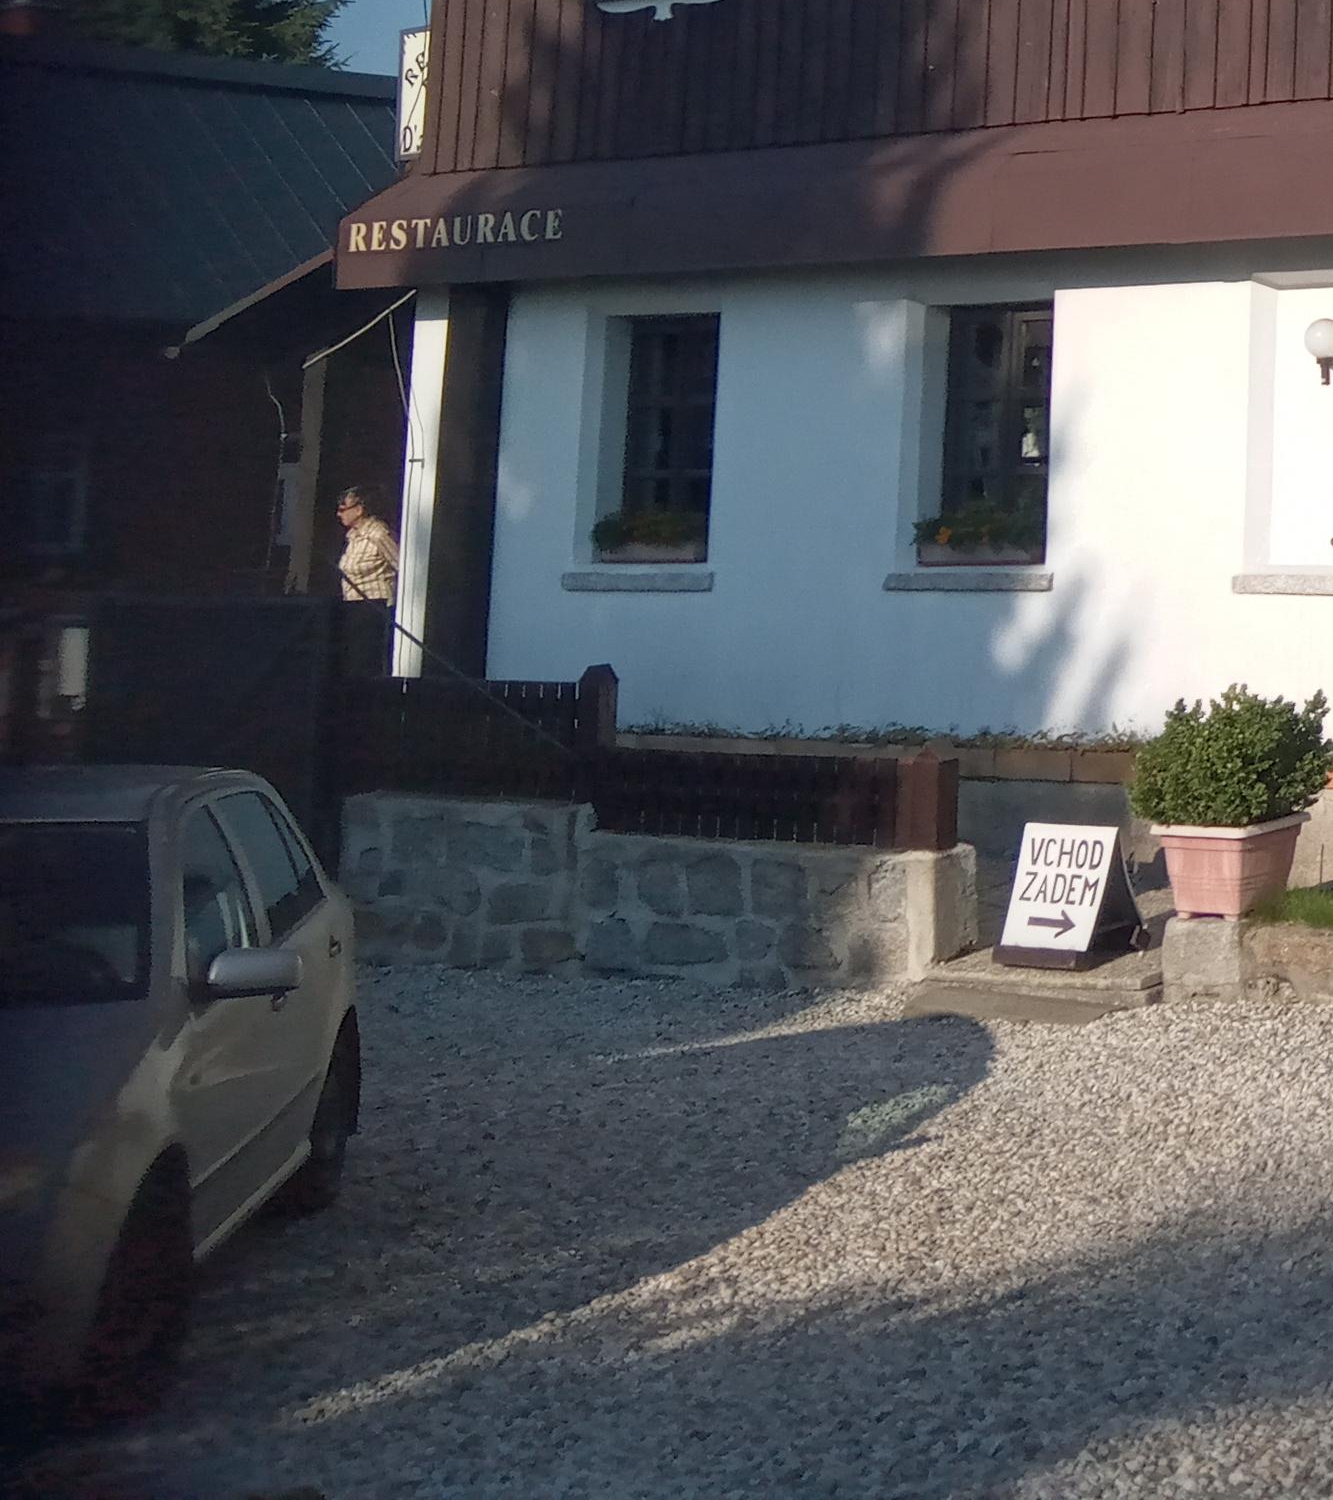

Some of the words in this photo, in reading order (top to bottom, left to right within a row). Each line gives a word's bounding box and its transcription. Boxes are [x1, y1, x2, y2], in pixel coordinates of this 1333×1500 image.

[347, 208, 563, 253] RESTAURACE
[1031, 837, 1105, 870] VCHOD
[1019, 871, 1100, 907] ZADEM
